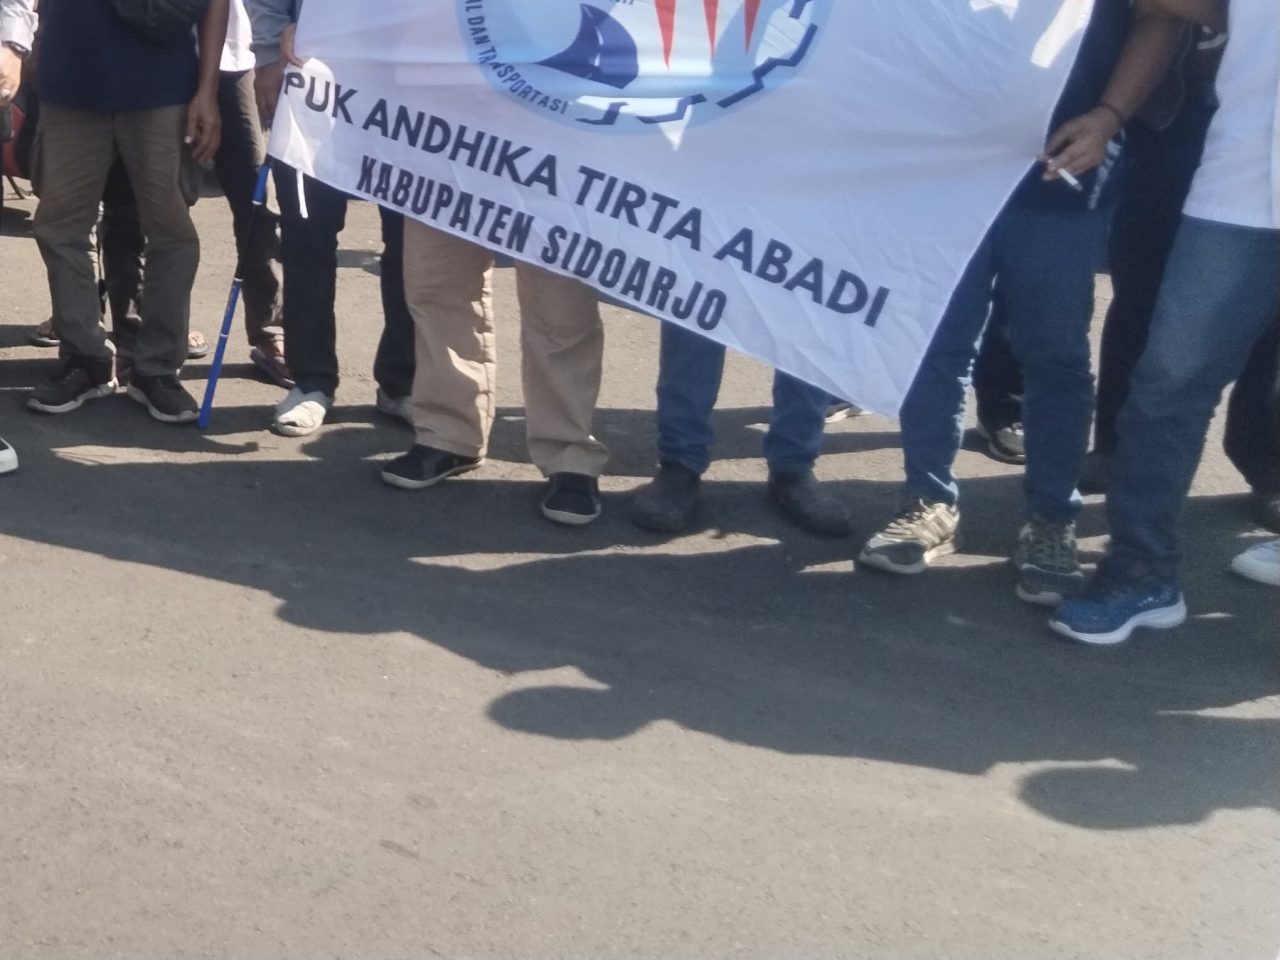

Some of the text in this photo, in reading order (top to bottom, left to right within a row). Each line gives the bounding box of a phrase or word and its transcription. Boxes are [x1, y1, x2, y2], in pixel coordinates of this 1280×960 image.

[467, 15, 491, 45] DAN
[285, 71, 890, 328] PUK ANDHIKA TIRTA ABADI
[355, 155, 727, 331] KABUPATEN SIDOARJO
